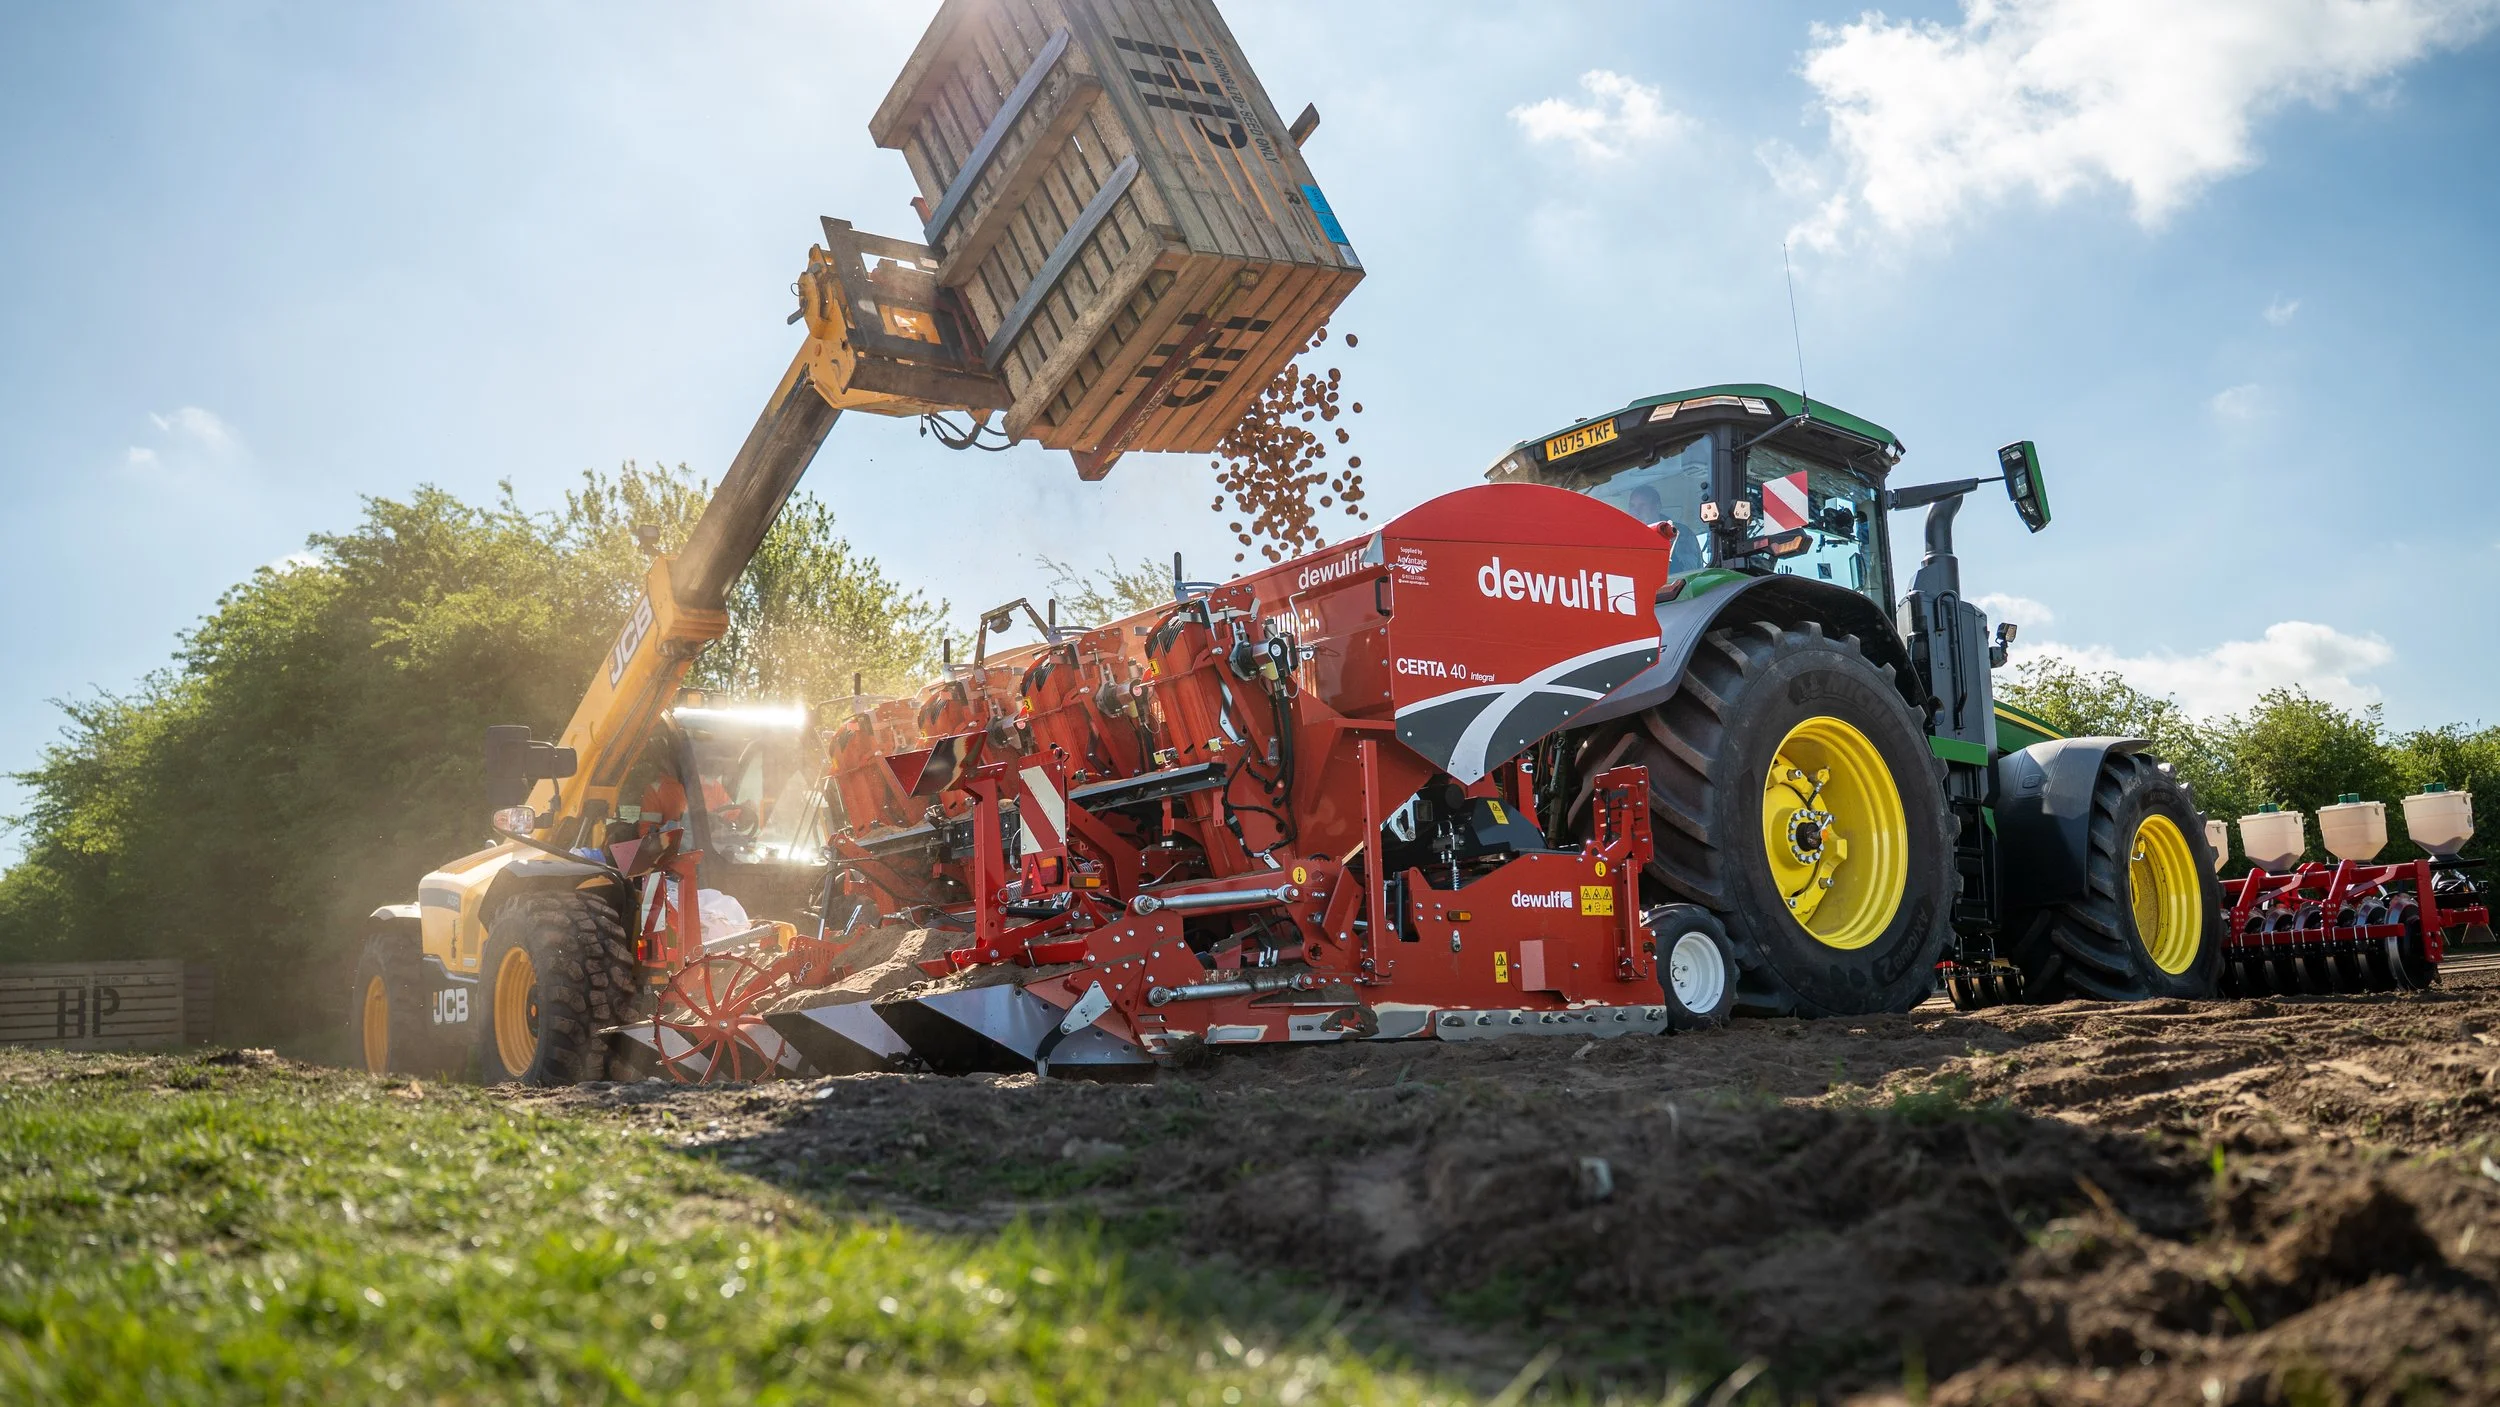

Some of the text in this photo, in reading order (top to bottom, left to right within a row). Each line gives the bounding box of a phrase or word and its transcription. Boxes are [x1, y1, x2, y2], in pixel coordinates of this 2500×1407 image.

[1112, 36, 1247, 149] HP
[1240, 111, 1264, 135] SEED
[1256, 138, 1280, 164] ONLY
[1553, 423, 1610, 456] AU75 TKF
[1298, 550, 1358, 590] dewulf
[1478, 556, 1603, 611] dewulf
[609, 594, 653, 685] JCB
[1396, 657, 1447, 679] CERTA
[1450, 663, 1467, 680] 40
[1511, 889, 1560, 908] dewulf
[1878, 955, 1897, 984] 2
[57, 986, 120, 1040] HP
[432, 987, 469, 1025] JCB
